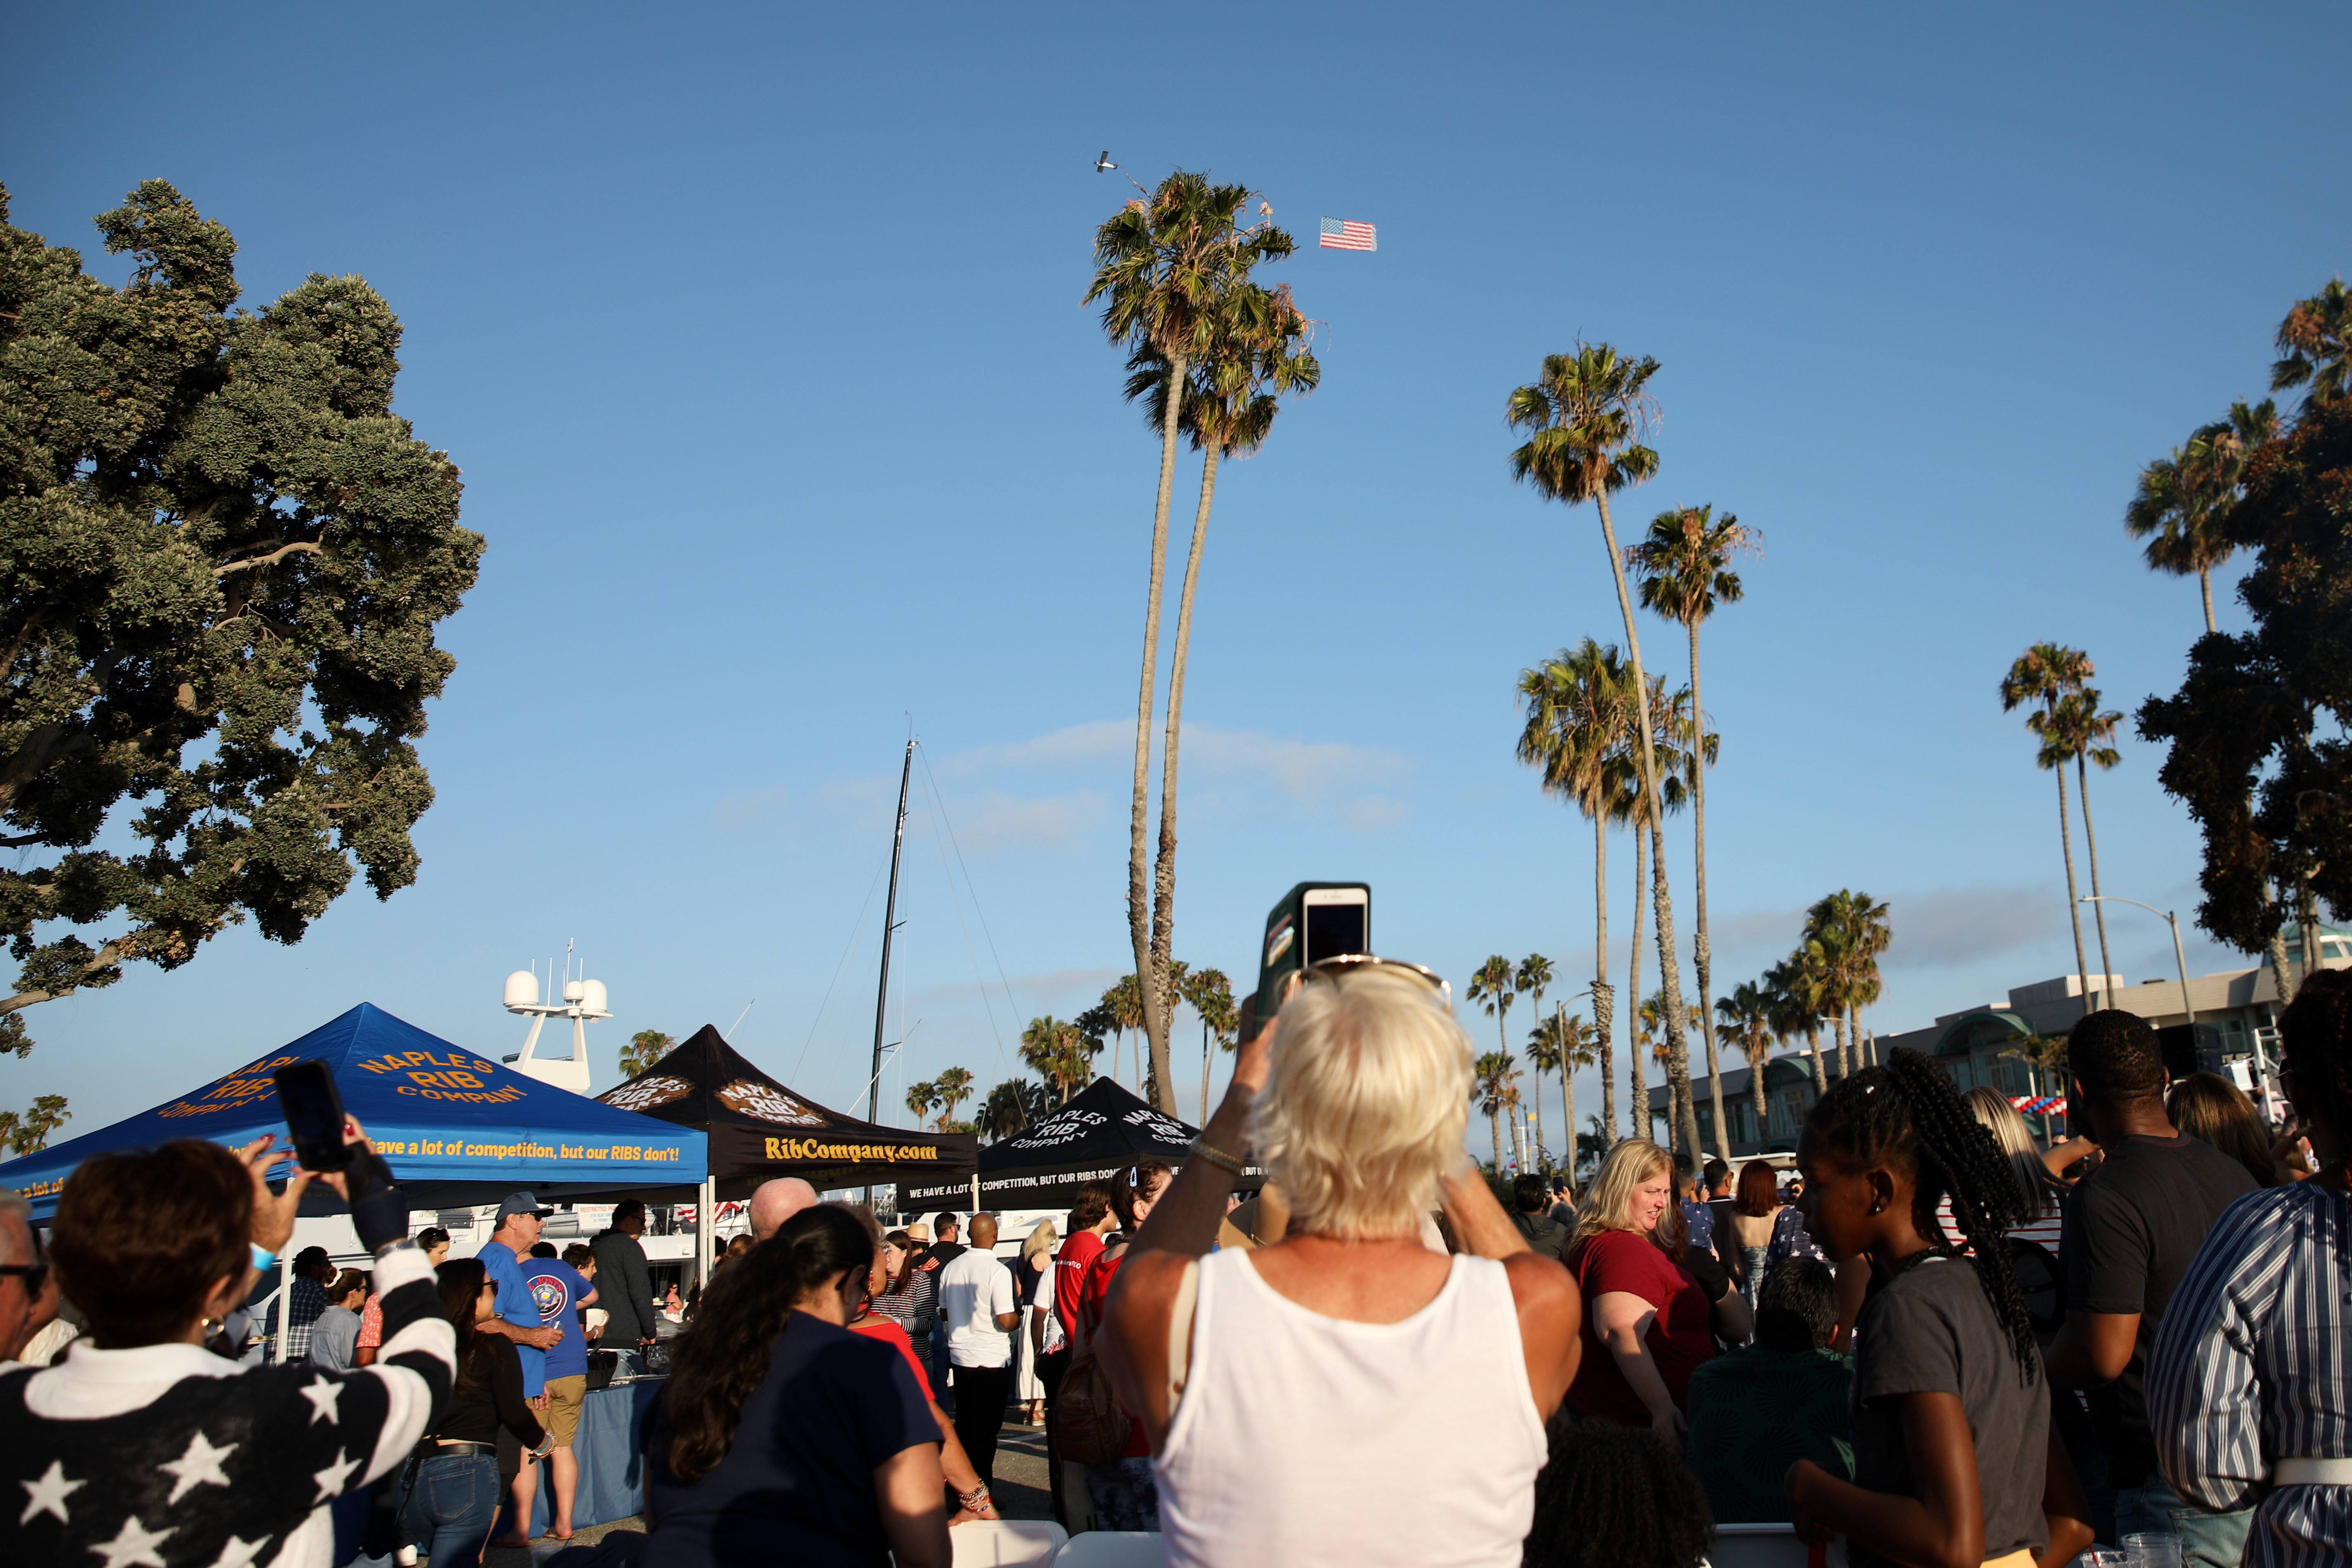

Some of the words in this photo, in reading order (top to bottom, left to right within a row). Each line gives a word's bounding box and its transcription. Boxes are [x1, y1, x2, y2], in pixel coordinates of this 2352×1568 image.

[357, 1051, 494, 1074] NAPLES
[200, 1078, 276, 1100] RIB
[406, 1071, 485, 1088] RIB
[157, 1089, 278, 1118] COMPANY
[397, 1084, 528, 1104] COMPANY
[605, 1088, 659, 1105] RIB
[739, 1107, 823, 1125] COMPANY
[744, 1097, 797, 1116] RIB
[1034, 1110, 1108, 1130] NAPLES
[1122, 1110, 1183, 1129] NAPLES
[1010, 1130, 1088, 1149] COMPANY
[1034, 1123, 1080, 1138] RIB
[1147, 1123, 1187, 1137] RIB
[408, 1142, 418, 1154] a
[421, 1139, 443, 1155] lot
[445, 1140, 463, 1156] of
[465, 1142, 557, 1160] competition,
[560, 1144, 584, 1159] but
[586, 1148, 609, 1159] our
[611, 1145, 641, 1161] RIBS
[764, 1137, 938, 1163] RibCompany.com
[1245, 1167, 1256, 1176] BUT
[23, 1187, 32, 1199] a
[32, 1181, 49, 1197] lot
[51, 1177, 64, 1193] of
[909, 1189, 922, 1199] WE
[923, 1187, 945, 1197] HAVE
[946, 1186, 953, 1194] A
[953, 1184, 969, 1194] LOT
[982, 1176, 1038, 1191] COMPETITION,
[1040, 1175, 1057, 1185] BUT
[1058, 1173, 1076, 1183] OUR
[1076, 1170, 1097, 1182] RIBS
